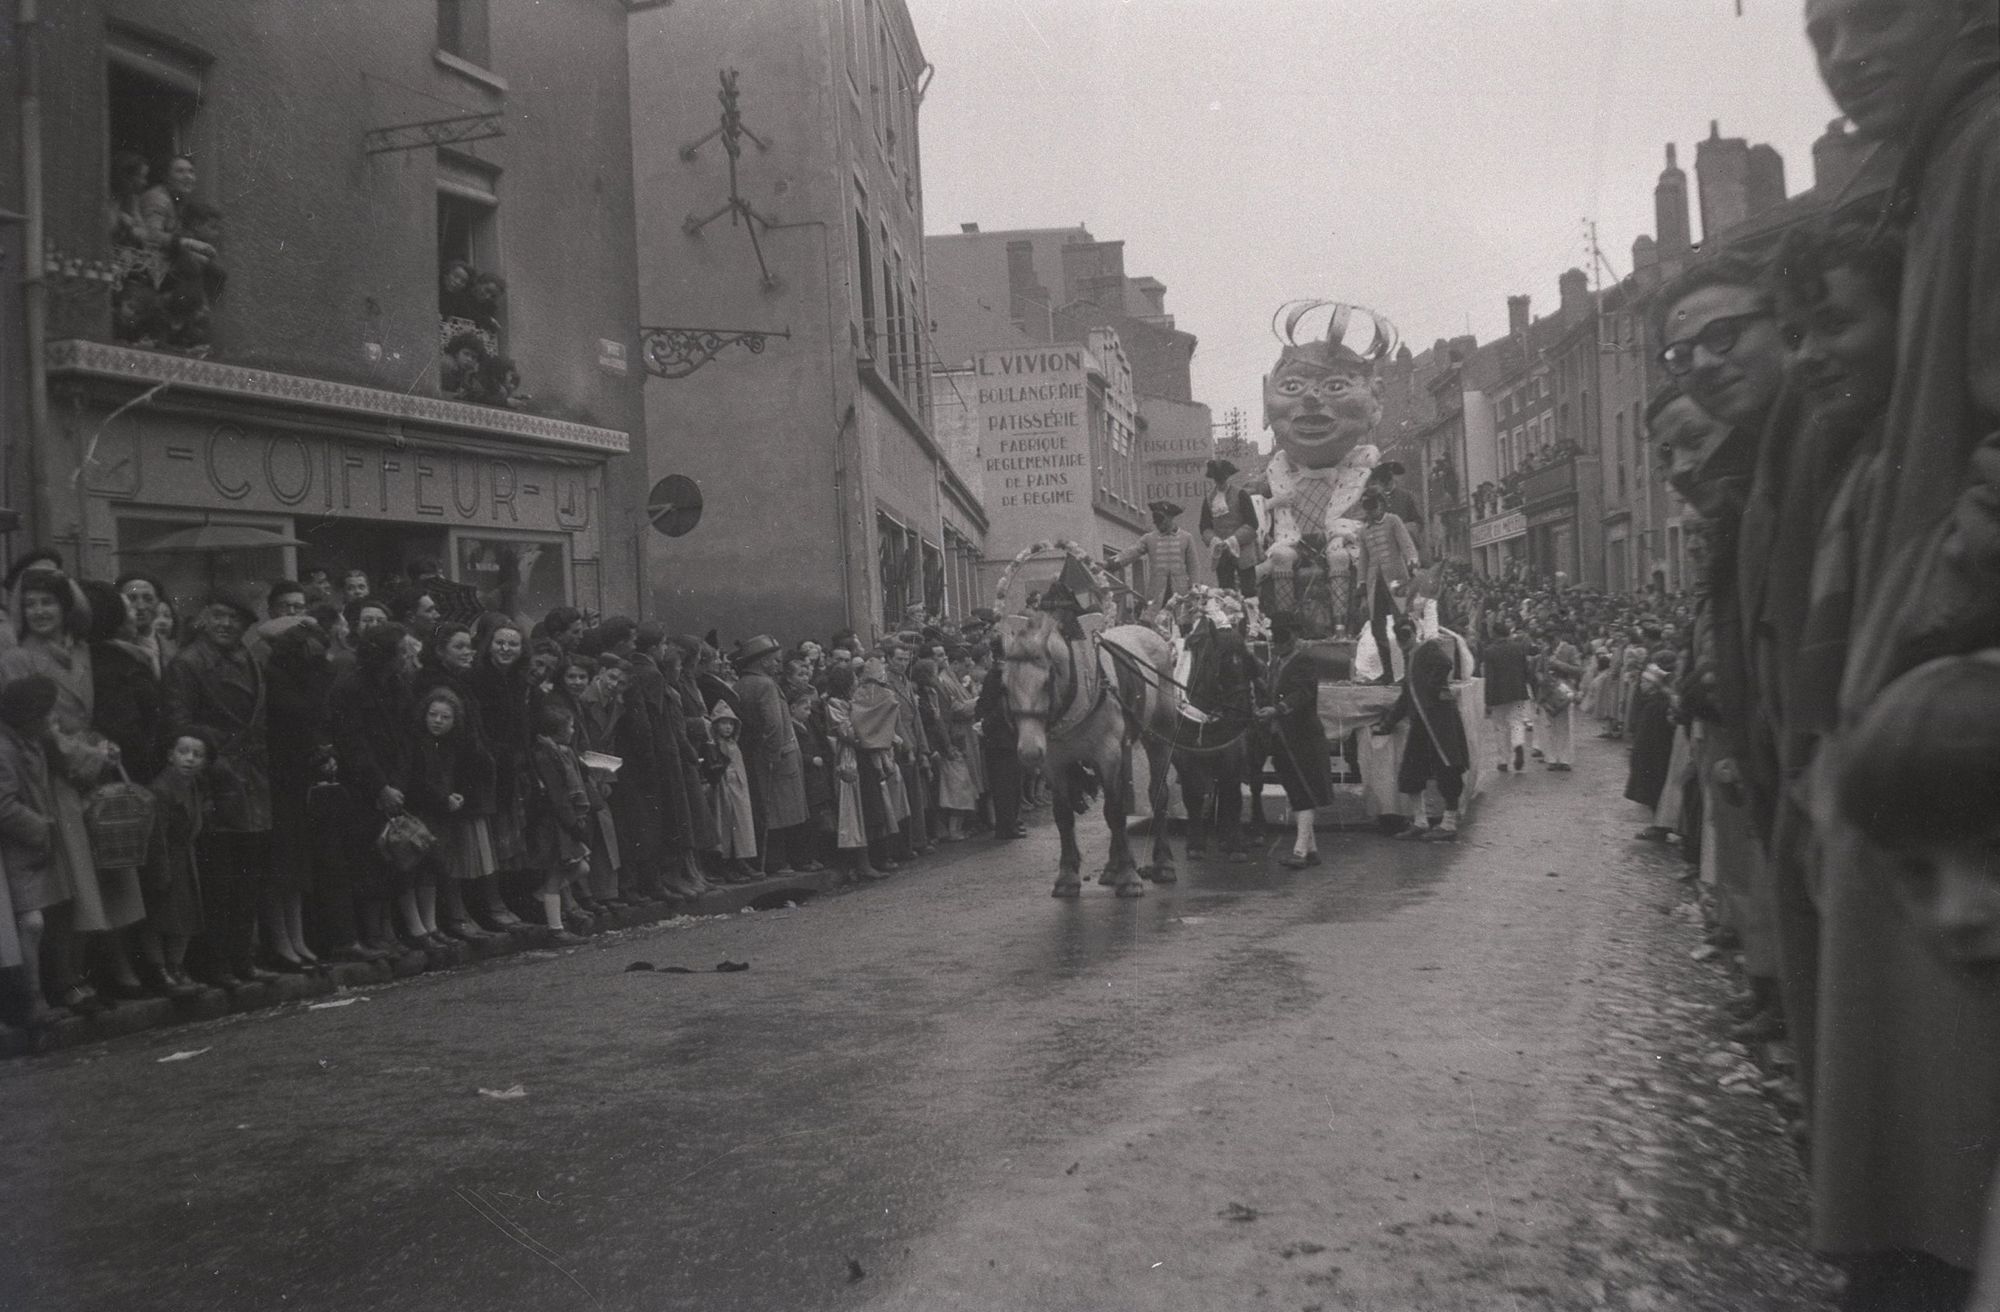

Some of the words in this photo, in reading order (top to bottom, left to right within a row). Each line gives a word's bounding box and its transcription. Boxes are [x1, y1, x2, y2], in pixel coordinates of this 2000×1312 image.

[979, 383, 1084, 404] BOULANGERIE
[999, 436, 1069, 453] FABRIQUE
[1005, 476, 1021, 489] DE
[1026, 472, 1069, 488] PAINS
[1146, 480, 1213, 500] DOCTEUR
[1001, 494, 1018, 507] DE
